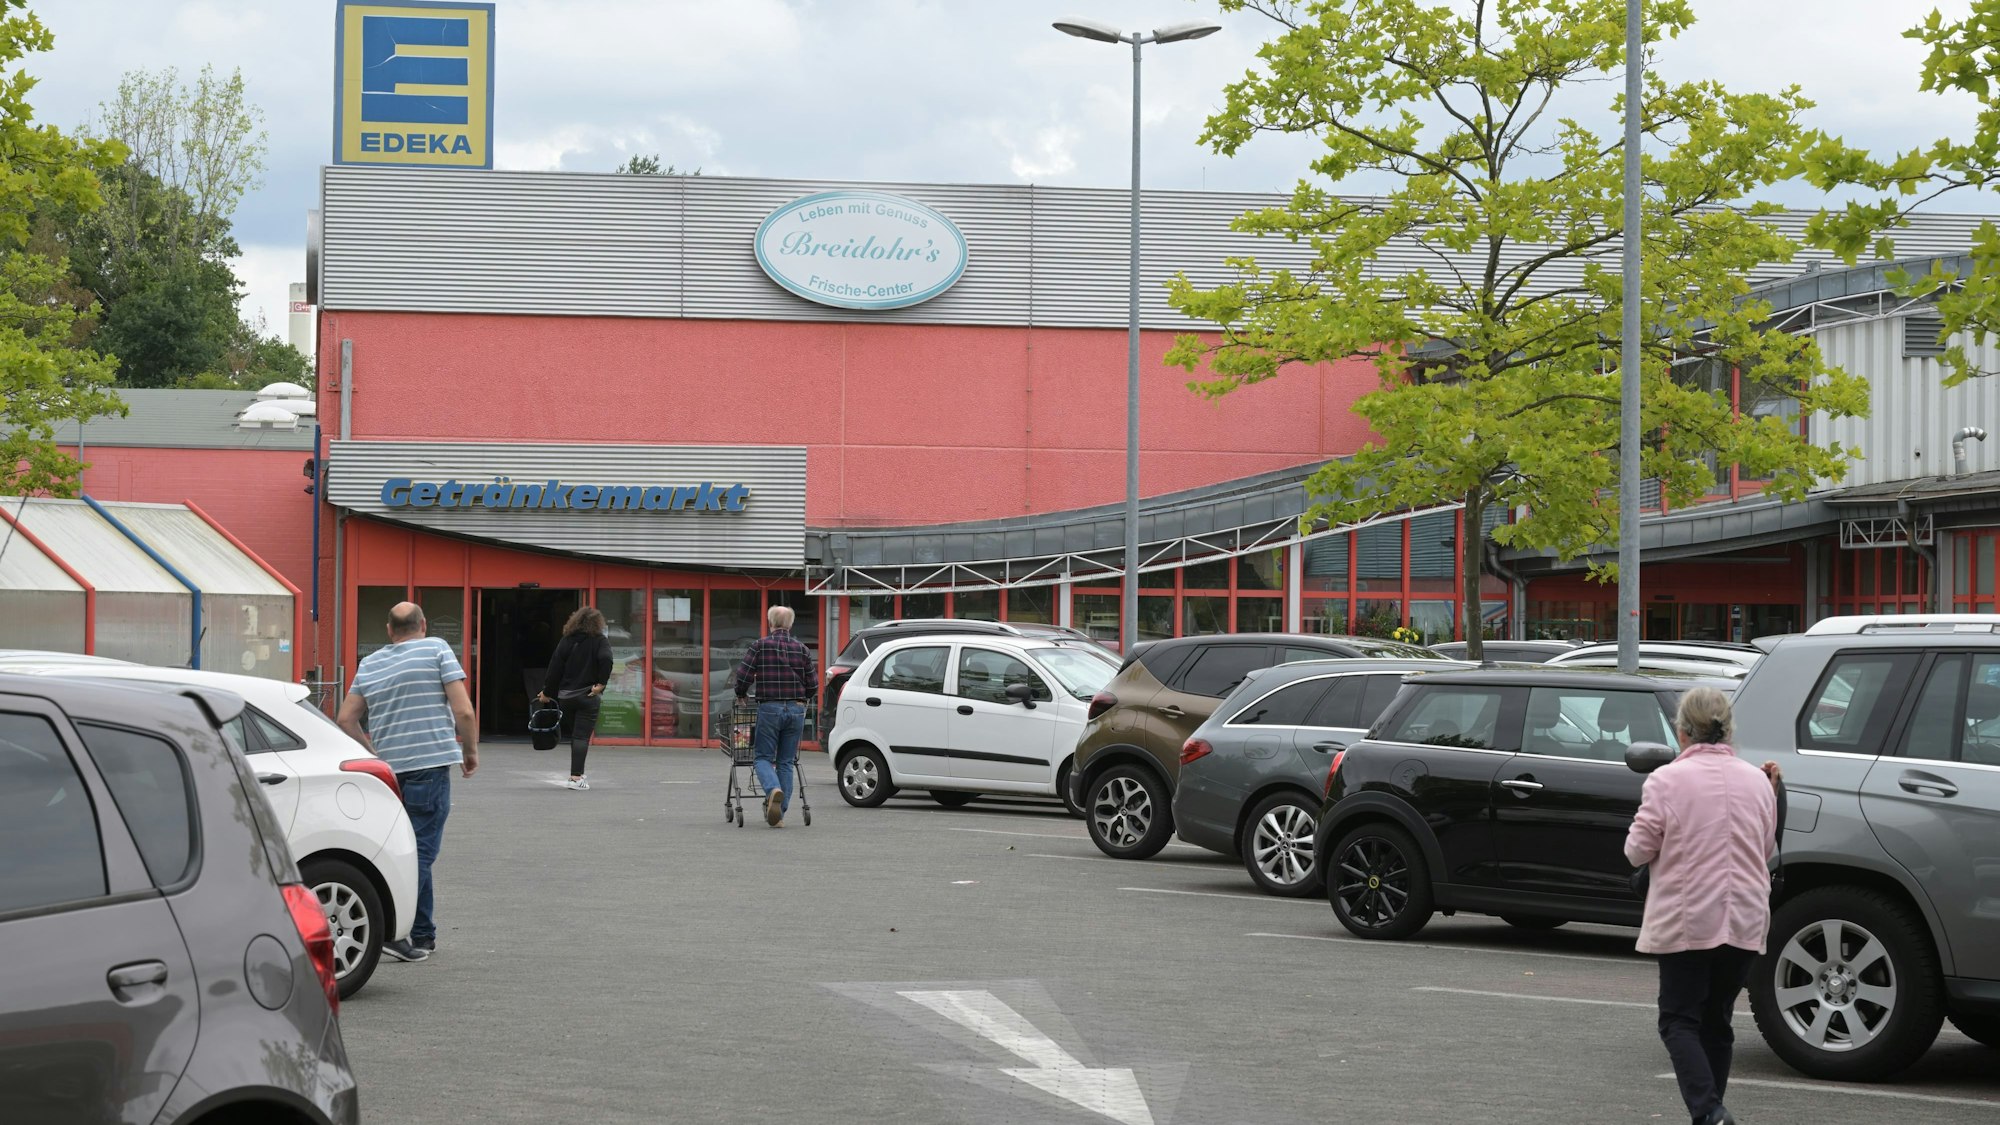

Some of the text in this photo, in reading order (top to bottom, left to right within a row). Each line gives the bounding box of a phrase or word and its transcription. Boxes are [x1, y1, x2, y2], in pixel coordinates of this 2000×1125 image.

[361, 132, 473, 155] EDEKA
[799, 202, 929, 230] Leben mit Genuss
[779, 230, 940, 263] Breidohr's
[808, 274, 915, 297] Frische-Center
[380, 475, 753, 513] Getränkemarkt
